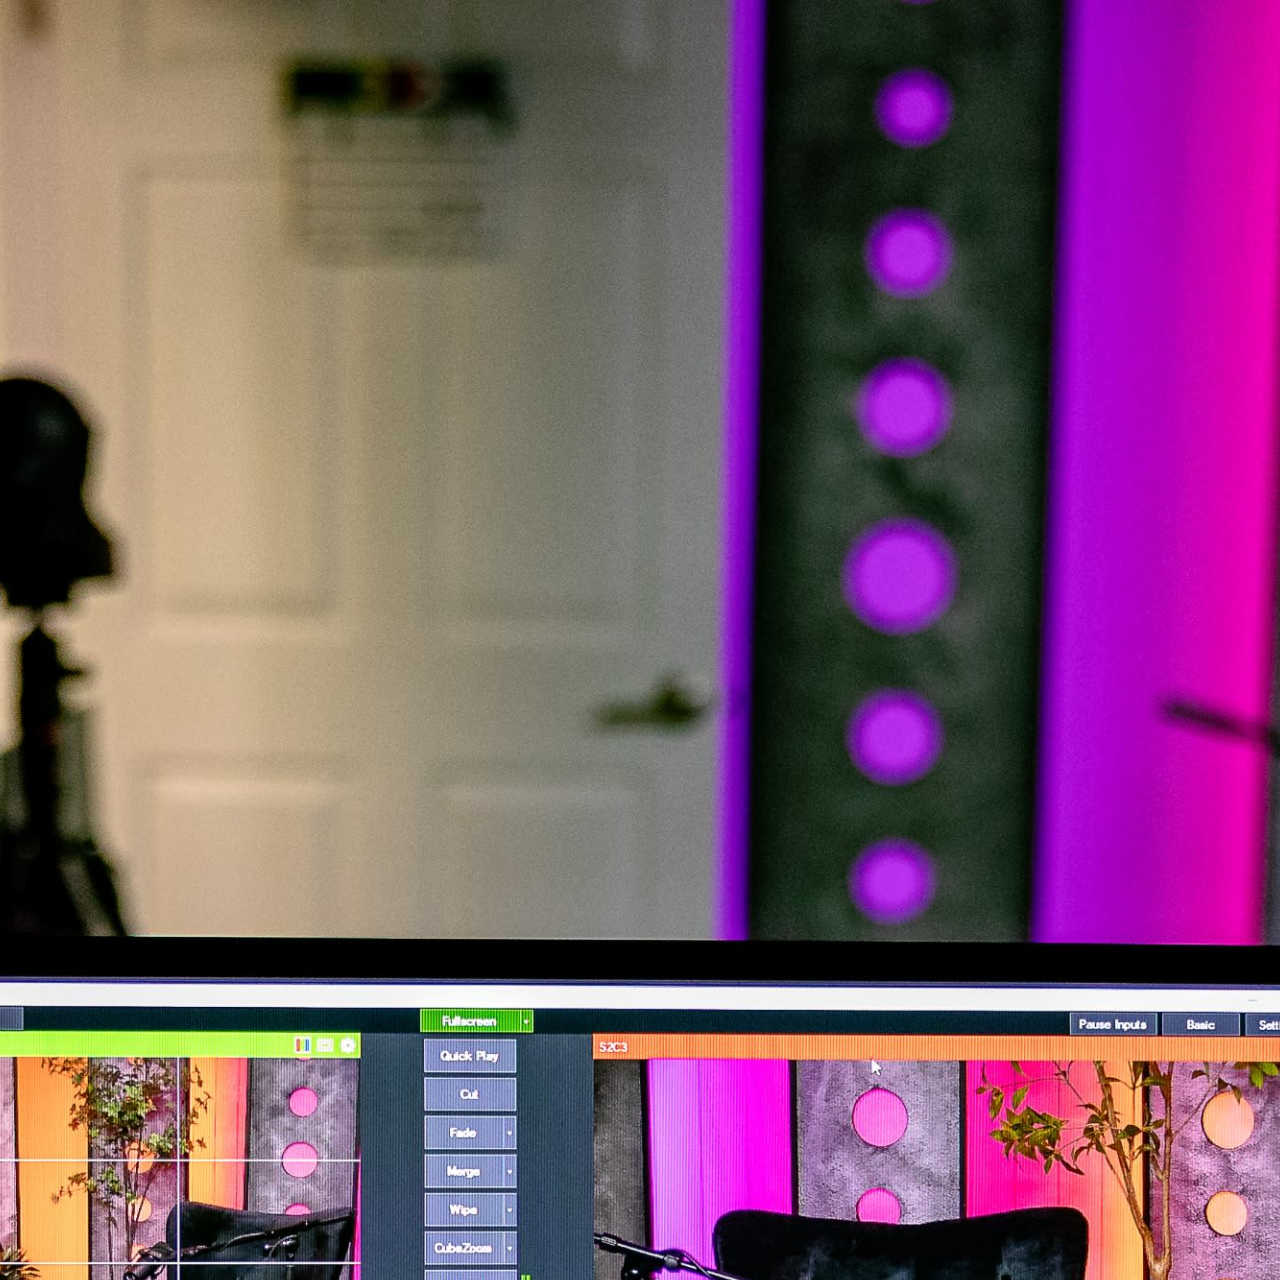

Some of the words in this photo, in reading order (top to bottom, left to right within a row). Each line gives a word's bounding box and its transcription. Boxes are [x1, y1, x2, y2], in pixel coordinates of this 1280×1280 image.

[442, 1016, 497, 1027] Fullscreen
[1079, 1020, 1111, 1030] Pause
[1115, 1020, 1147, 1031] Inputs
[1187, 1020, 1215, 1030] Basic
[599, 1042, 628, 1053] S2C3
[440, 1051, 472, 1063] Quick
[477, 1051, 499, 1064] Play
[460, 1089, 479, 1100] Cut
[450, 1127, 476, 1139] Fade
[447, 1166, 481, 1179] Merge
[449, 1204, 477, 1216] Wipe
[434, 1242, 492, 1254] CubeZoom
